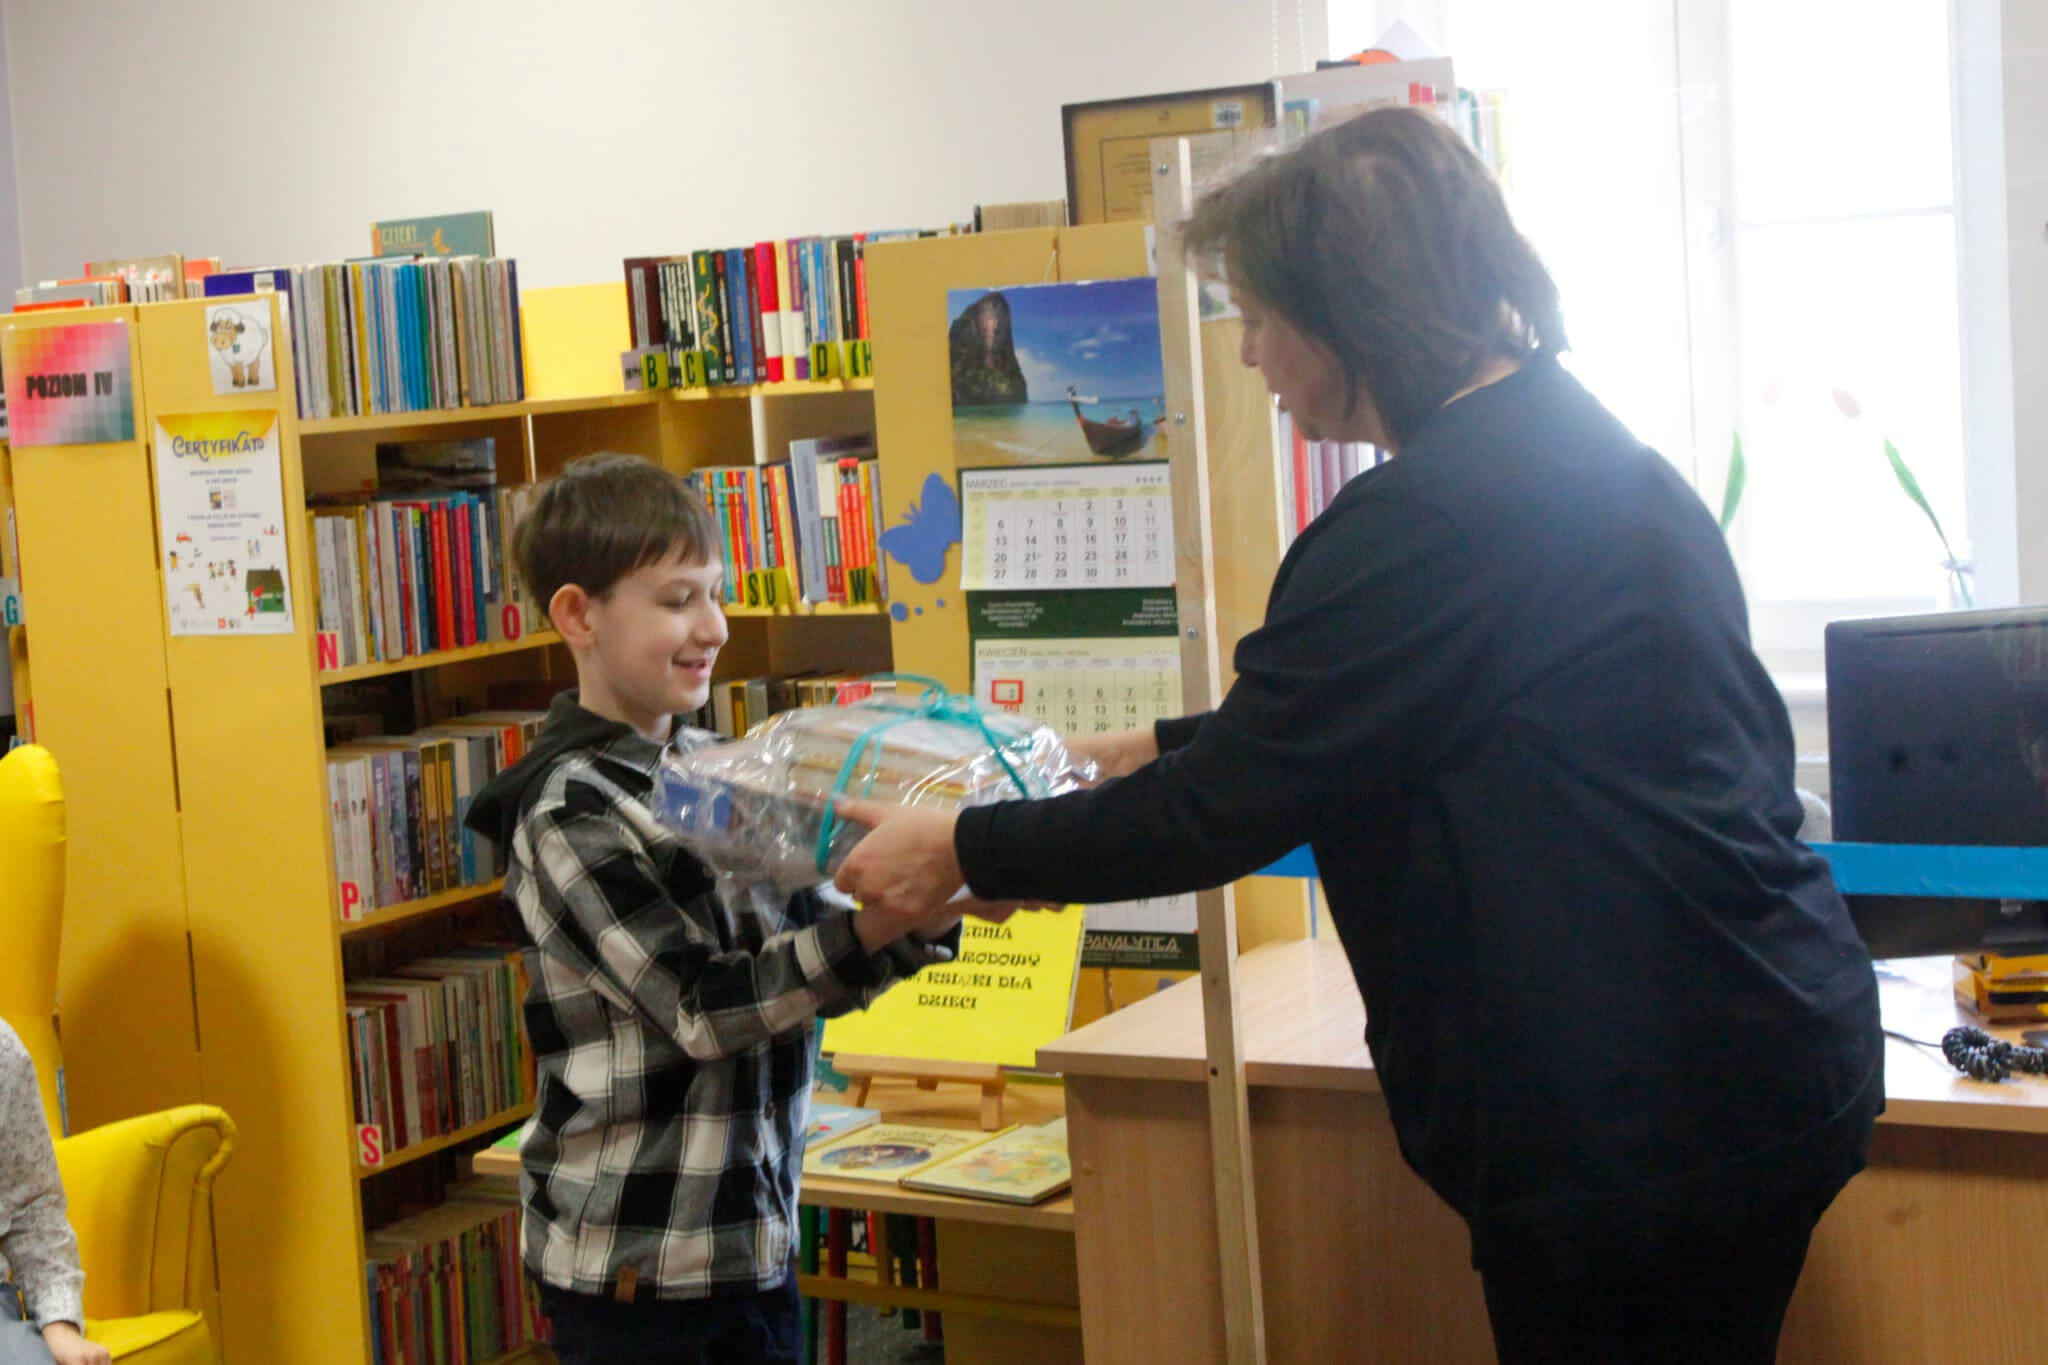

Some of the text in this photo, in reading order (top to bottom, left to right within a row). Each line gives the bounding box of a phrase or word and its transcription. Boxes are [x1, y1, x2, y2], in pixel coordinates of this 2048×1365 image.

[646, 353, 657, 387] B
[685, 353, 695, 384] C
[817, 345, 828, 377] D
[26, 371, 112, 399] POZIOM IV
[748, 574, 759, 606] S
[764, 571, 776, 604] U
[5, 594, 18, 625] G
[317, 632, 339, 670] N
[340, 881, 359, 920] P
[360, 1126, 380, 1165] S
